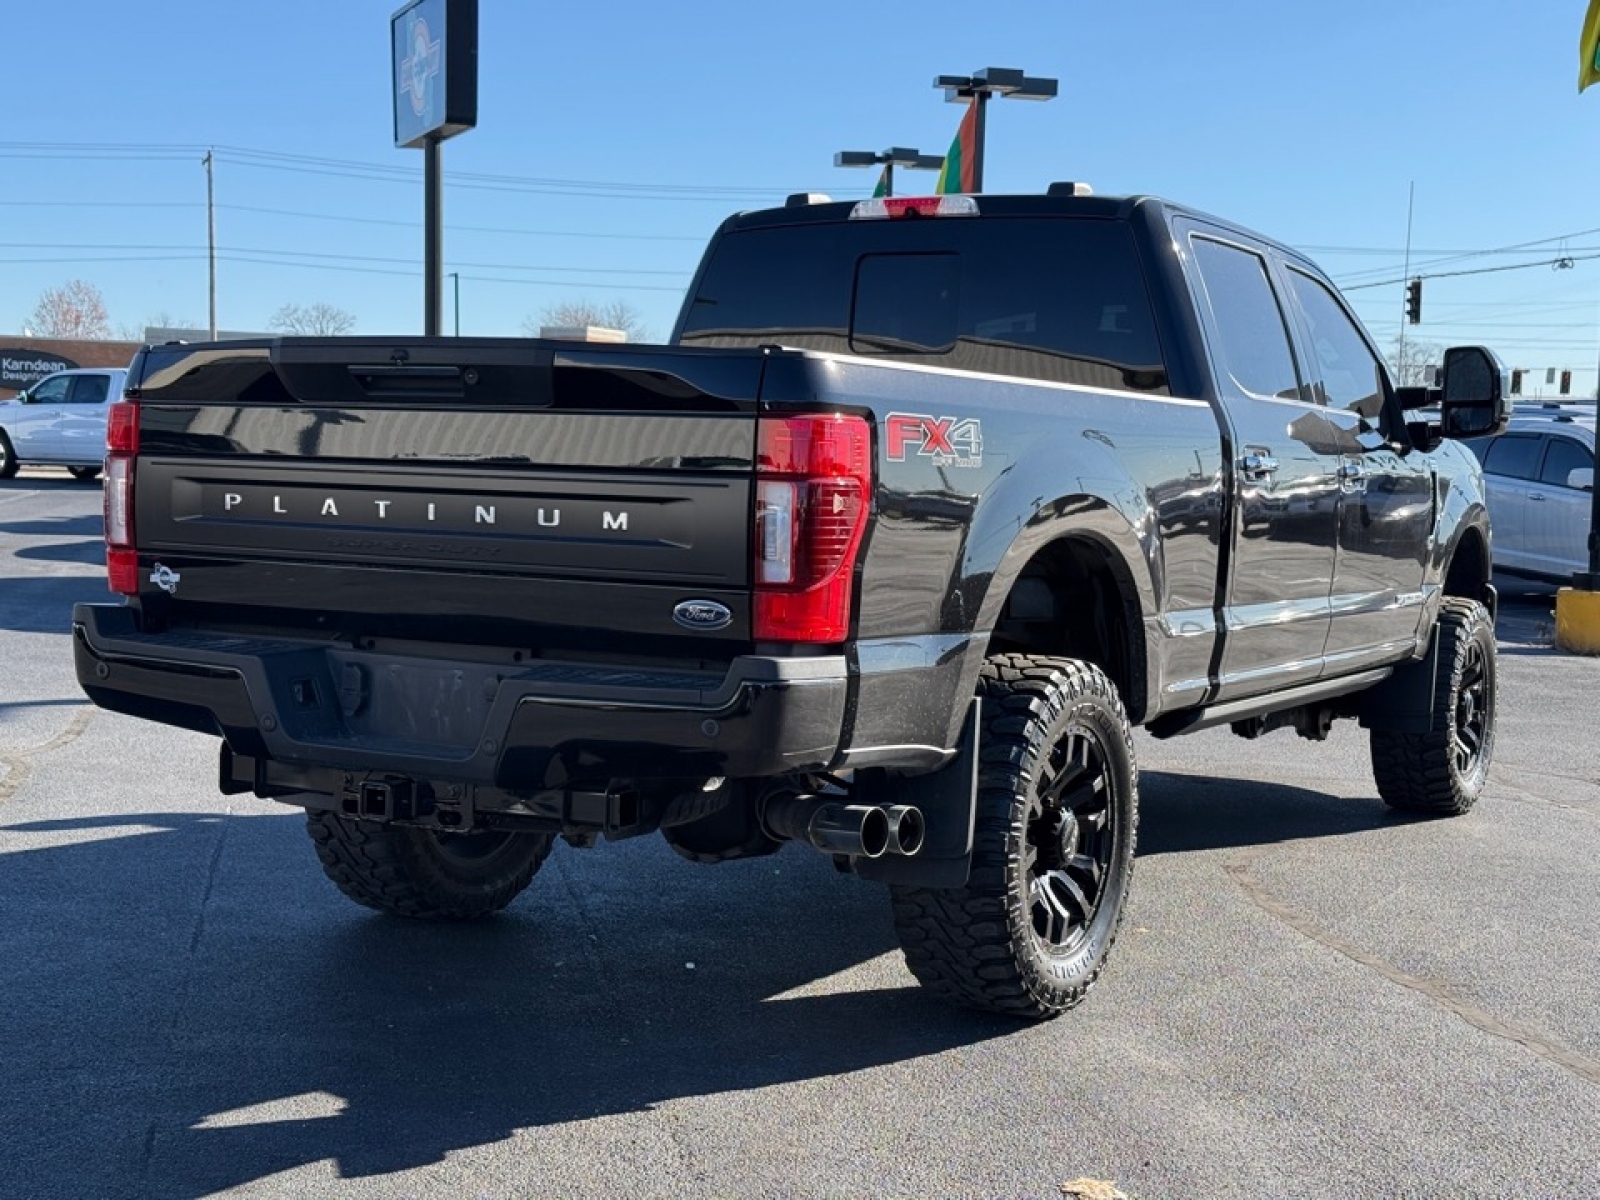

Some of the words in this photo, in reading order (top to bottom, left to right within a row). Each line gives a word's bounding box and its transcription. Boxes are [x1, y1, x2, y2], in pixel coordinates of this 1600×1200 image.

[2, 358, 66, 371] Karndean
[885, 411, 983, 462] FX4
[224, 492, 628, 531] PLATINUM
